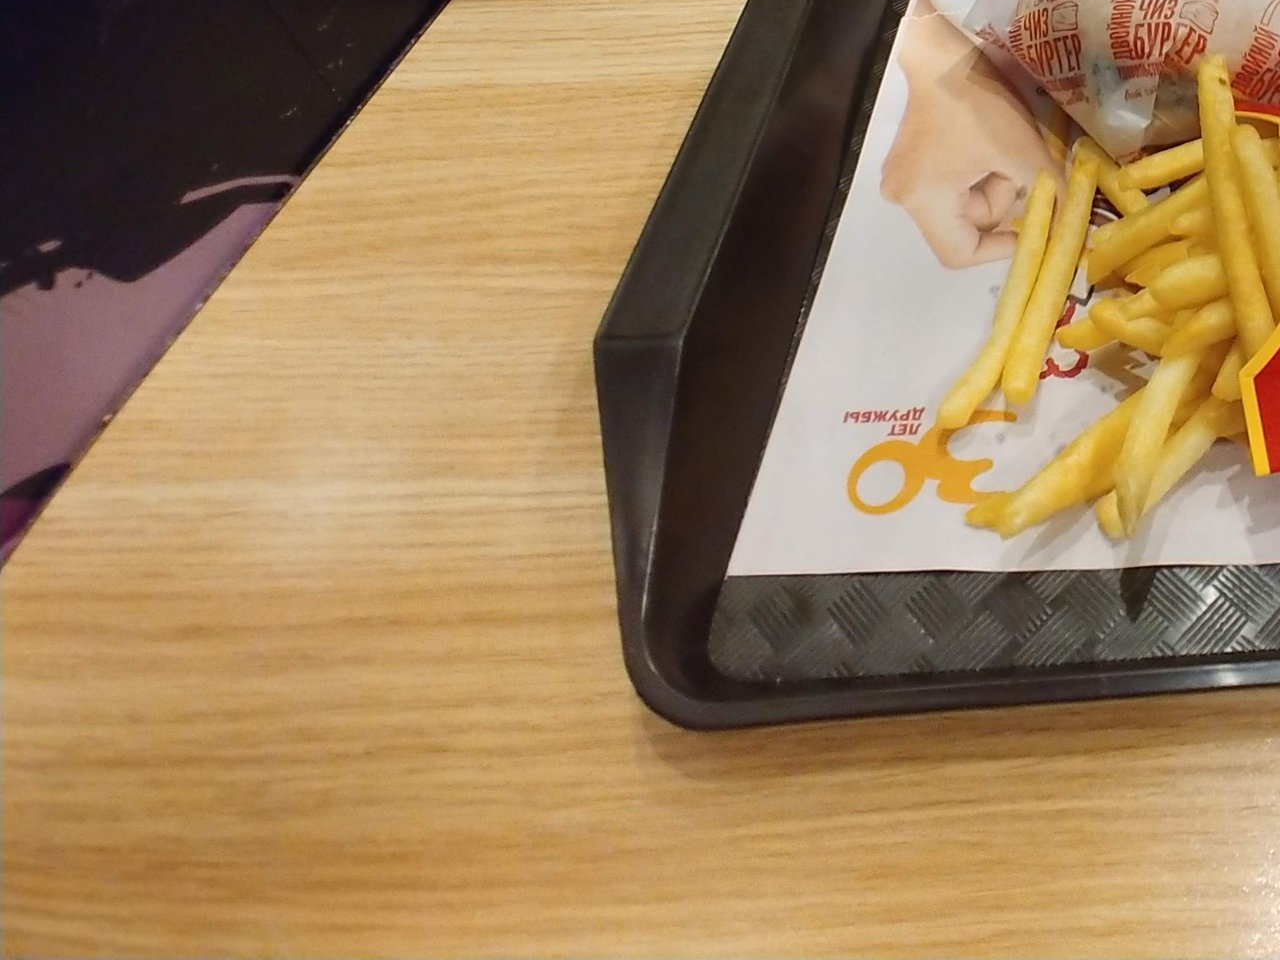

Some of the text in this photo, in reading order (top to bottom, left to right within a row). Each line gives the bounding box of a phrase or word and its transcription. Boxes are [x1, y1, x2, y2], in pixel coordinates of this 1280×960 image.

[1023, 7, 1049, 41] ЧИЗ
[1026, 33, 1081, 78] БУРГЕР
[1133, 21, 1207, 65] БУРГЕР
[842, 406, 926, 424] ДРУЖБЫ
[887, 423, 922, 437] ЛЕТ
